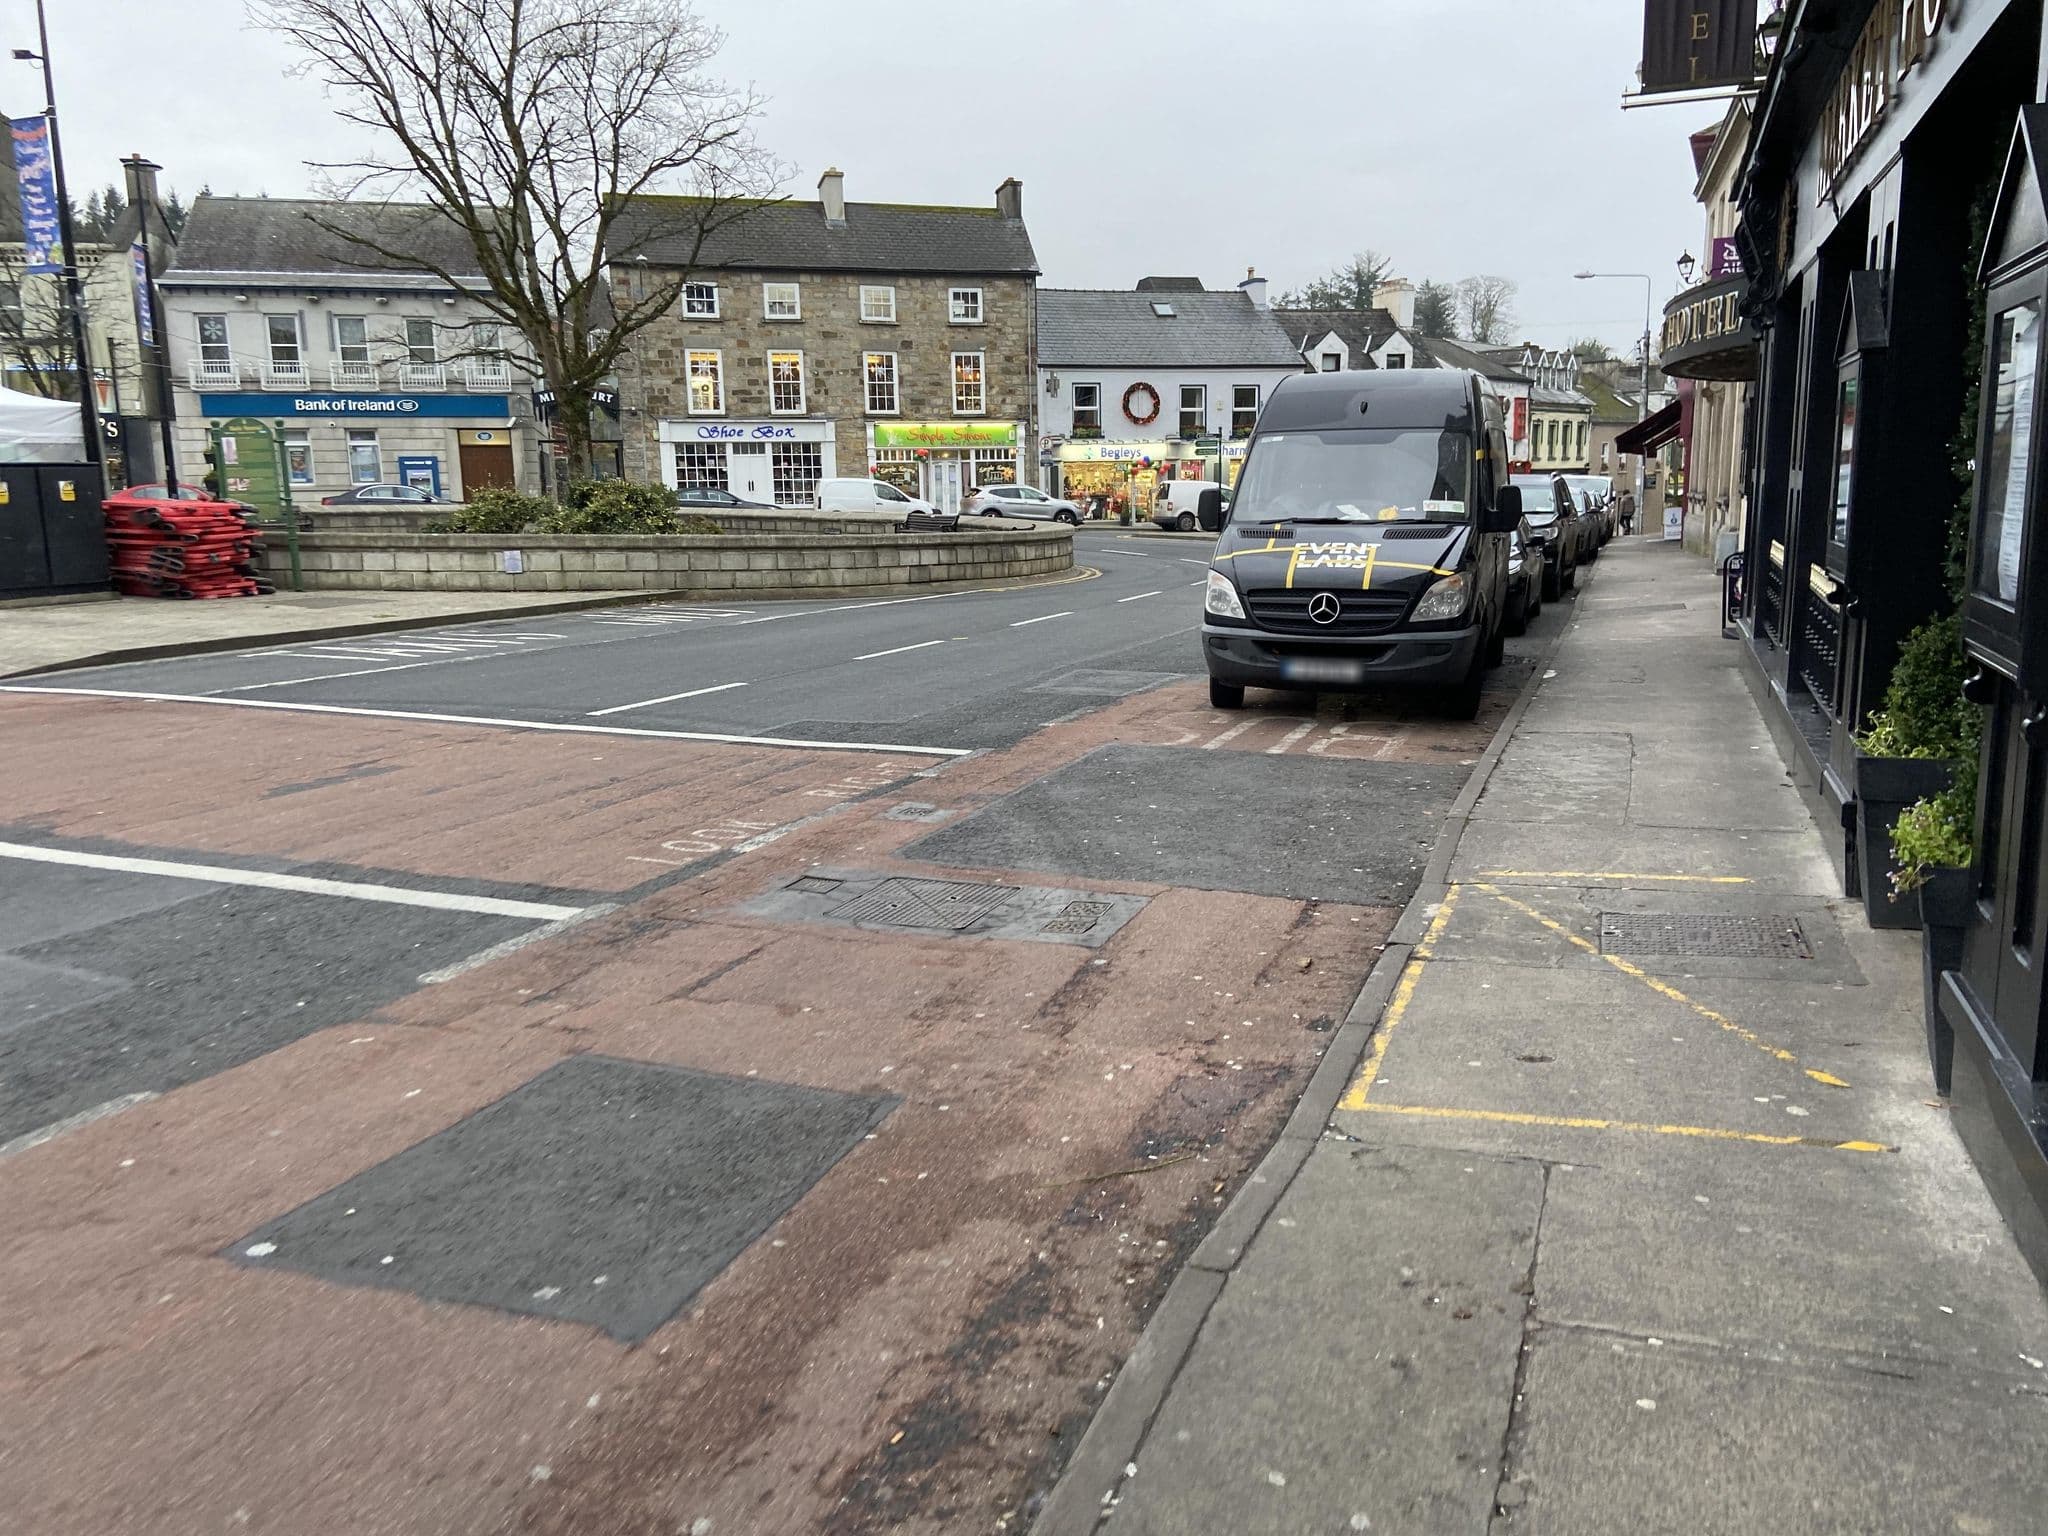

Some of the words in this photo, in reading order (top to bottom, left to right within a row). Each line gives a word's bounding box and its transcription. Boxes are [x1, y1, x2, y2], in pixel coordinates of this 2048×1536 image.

[1667, 291, 1744, 350] HOTEL
[294, 399, 330, 411] Bank
[332, 399, 346, 411] of
[348, 399, 395, 411] Ireland
[697, 425, 744, 439] Shoe
[751, 425, 796, 439] Box
[1101, 447, 1142, 460] Begleys
[1295, 542, 1382, 555] EVENT
[1296, 554, 1369, 569] LABS
[236, 629, 569, 663] TAXIS
